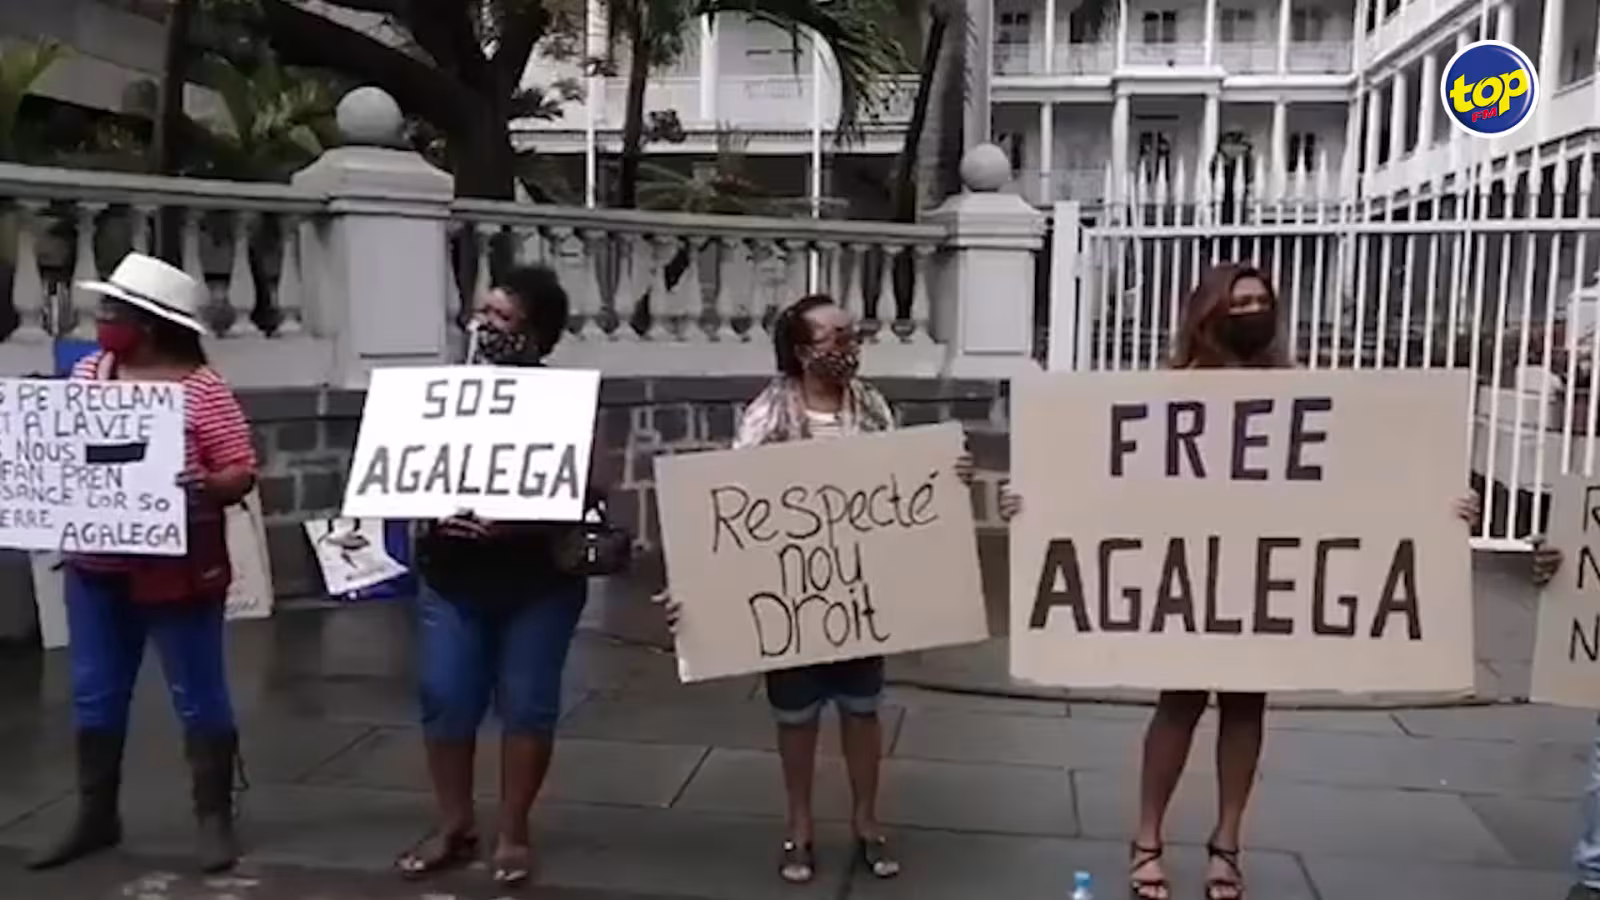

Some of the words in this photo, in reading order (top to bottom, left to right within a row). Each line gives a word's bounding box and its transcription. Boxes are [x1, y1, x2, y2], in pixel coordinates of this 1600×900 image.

[17, 384, 50, 411] PE
[65, 383, 173, 411] RECLAM
[422, 379, 517, 419] SOS
[24, 410, 44, 437] A
[1110, 397, 1333, 481] FREE
[16, 439, 76, 462] NOUS
[356, 443, 579, 498] AGALEGA
[61, 464, 122, 490] PREN
[710, 471, 939, 552] Respecté
[60, 521, 181, 549] AGALEGA
[776, 542, 862, 595] nou
[1029, 535, 1422, 641] AGALEGA
[748, 582, 890, 657] Droit
